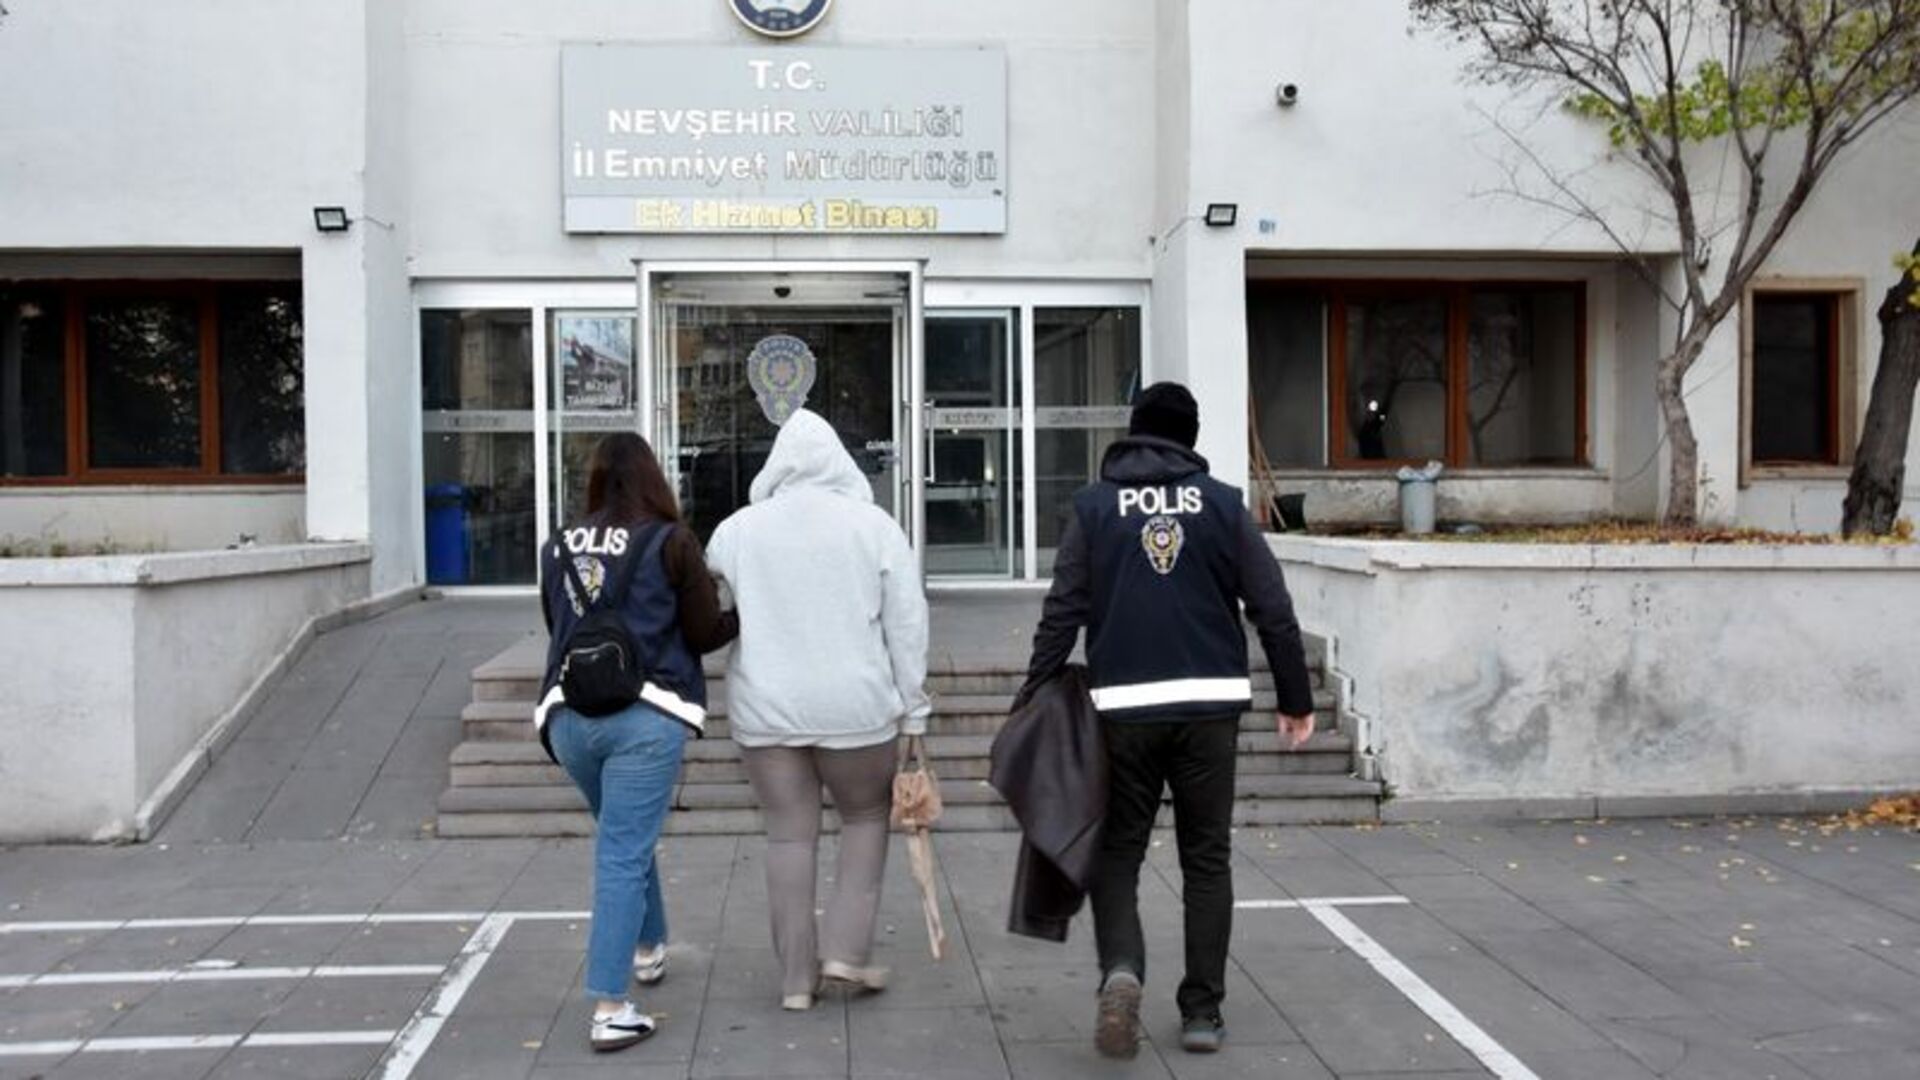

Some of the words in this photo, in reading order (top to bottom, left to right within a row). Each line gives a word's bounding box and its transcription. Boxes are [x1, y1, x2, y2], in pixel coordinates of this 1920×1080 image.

[748, 59, 826, 91] T.C.
[607, 104, 797, 140] NEVŞEHİR
[809, 105, 964, 137] VALİLİĞİ
[573, 142, 595, 178] İl
[605, 148, 769, 187] Emniyet
[784, 150, 999, 188] Müdürlüğü
[634, 200, 683, 228] Ek
[692, 200, 815, 229] Hizmet
[824, 200, 938, 229] Binası
